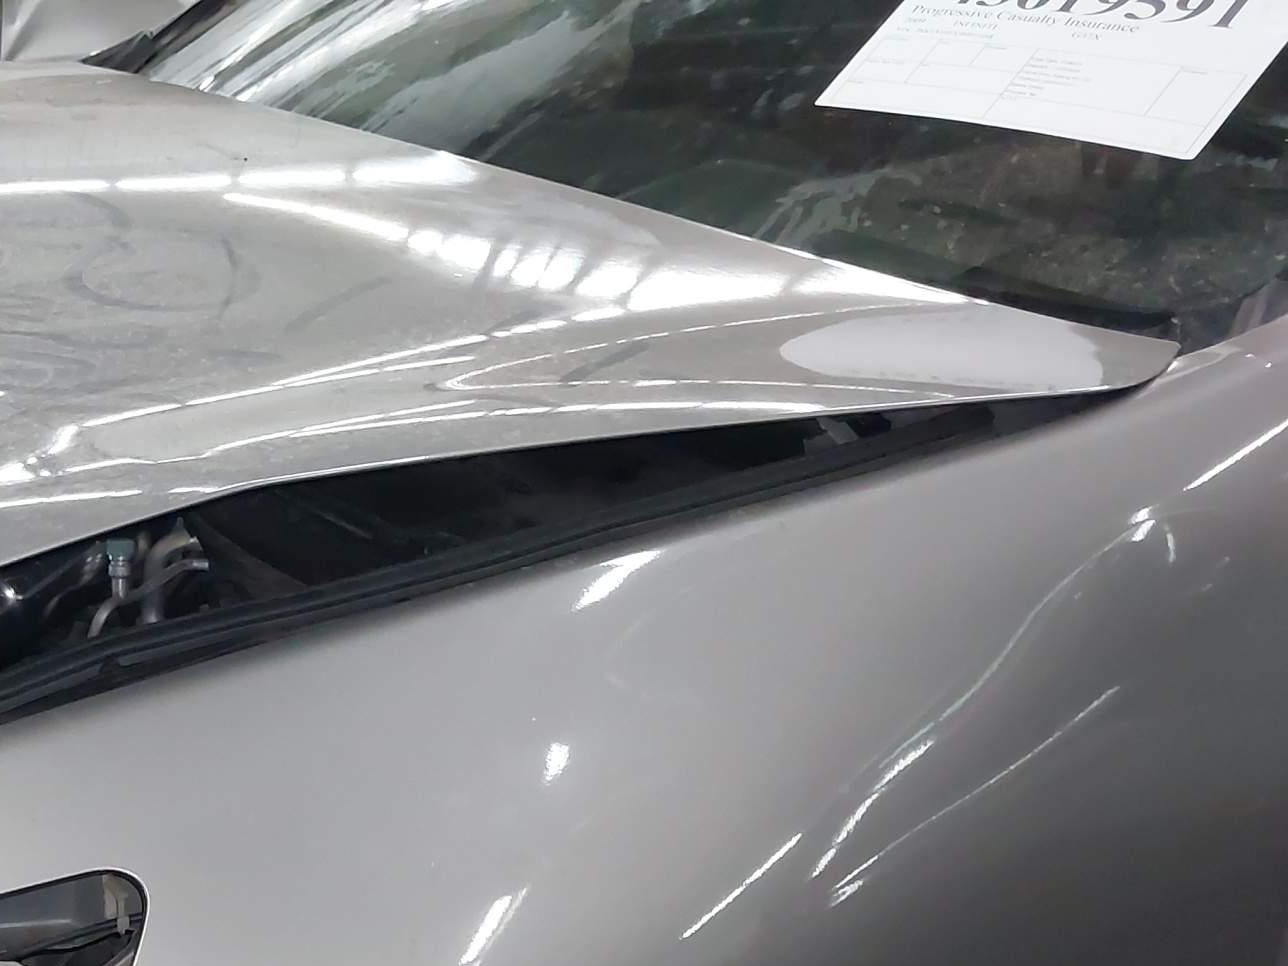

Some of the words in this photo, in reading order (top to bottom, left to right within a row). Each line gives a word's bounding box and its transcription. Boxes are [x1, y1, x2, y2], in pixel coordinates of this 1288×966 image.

[911, 4, 993, 19] Progressive
[996, 10, 1055, 26] Casualty
[1064, 16, 1140, 32] Insurance
